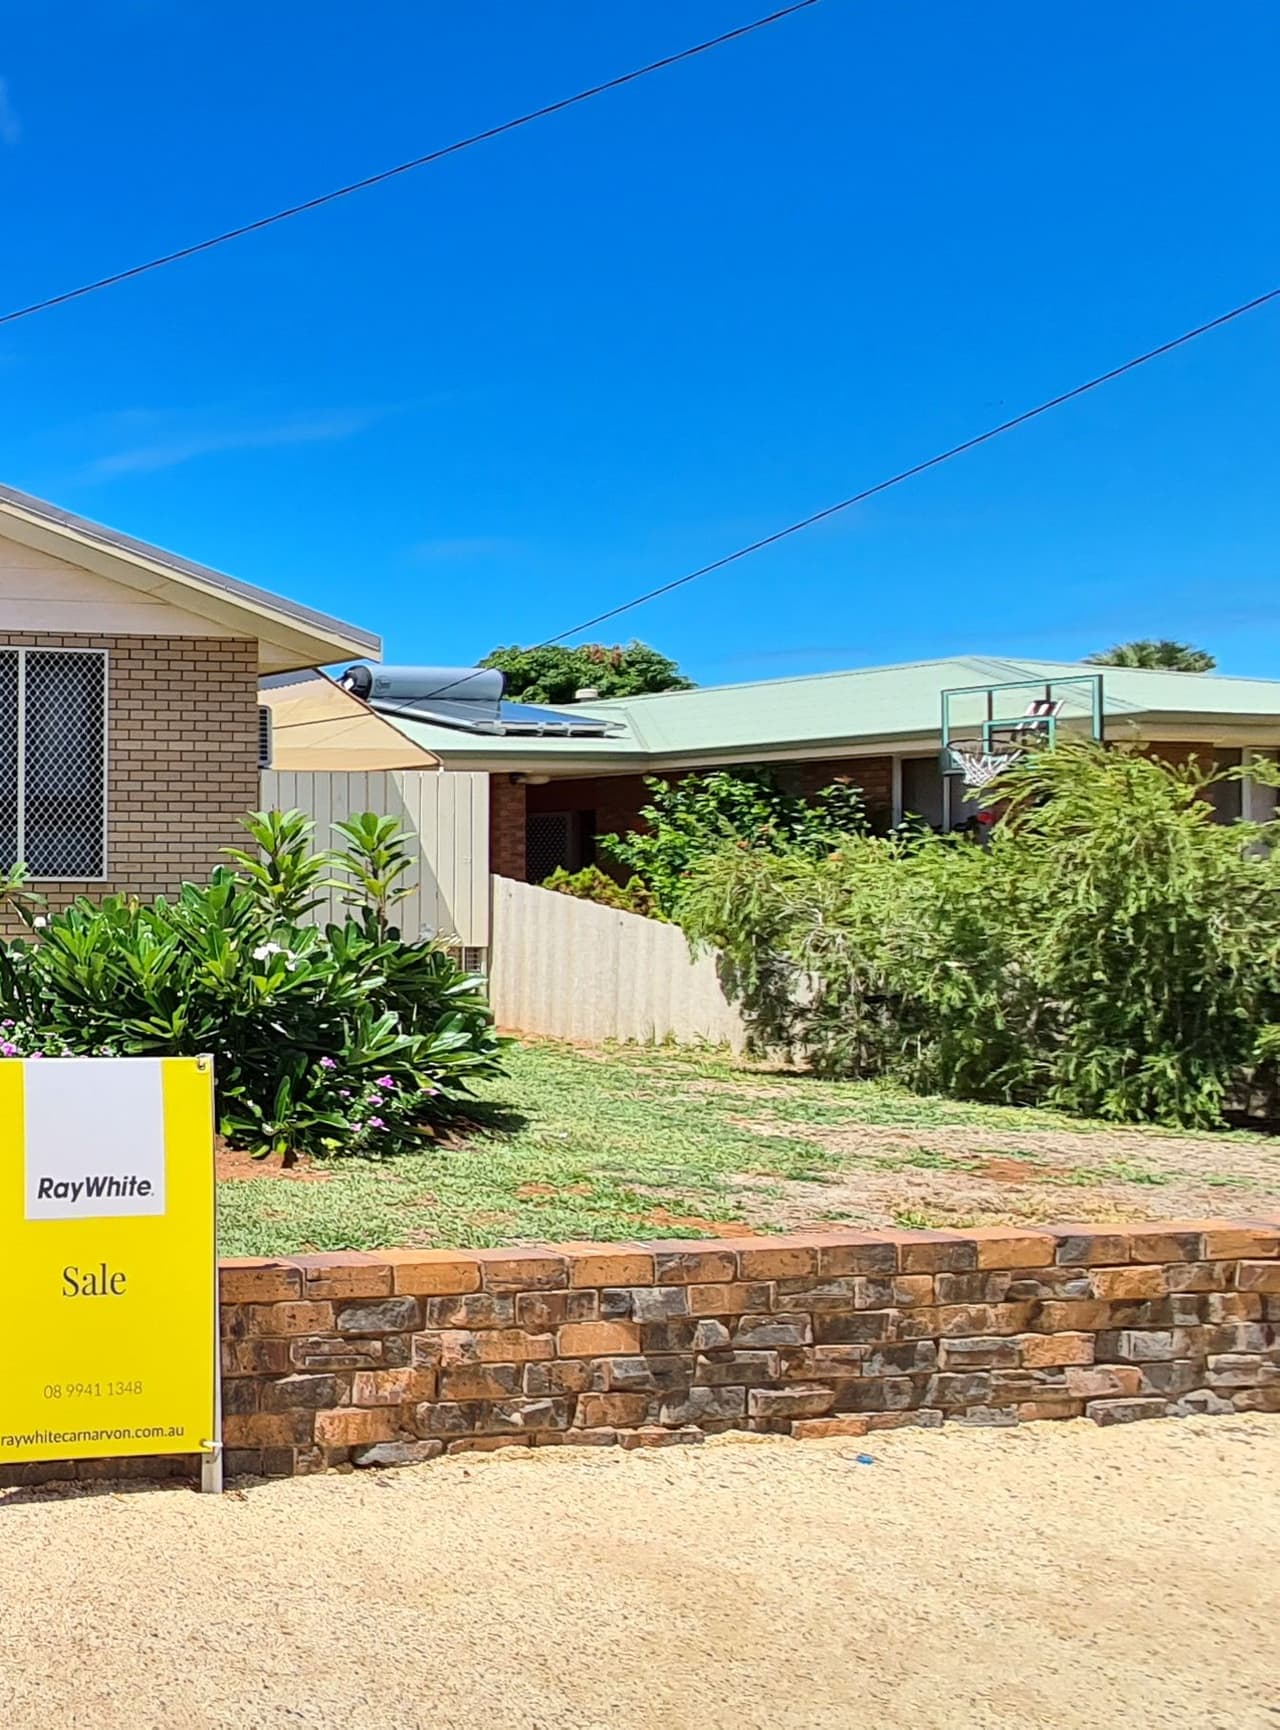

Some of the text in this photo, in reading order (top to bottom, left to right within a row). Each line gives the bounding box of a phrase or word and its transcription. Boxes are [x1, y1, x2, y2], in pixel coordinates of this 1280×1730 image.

[62, 1263, 127, 1297] Sale
[43, 1380, 143, 1399] 08 9941 1348
[0, 1426, 185, 1448] raywhitecarnarvon.com.au
